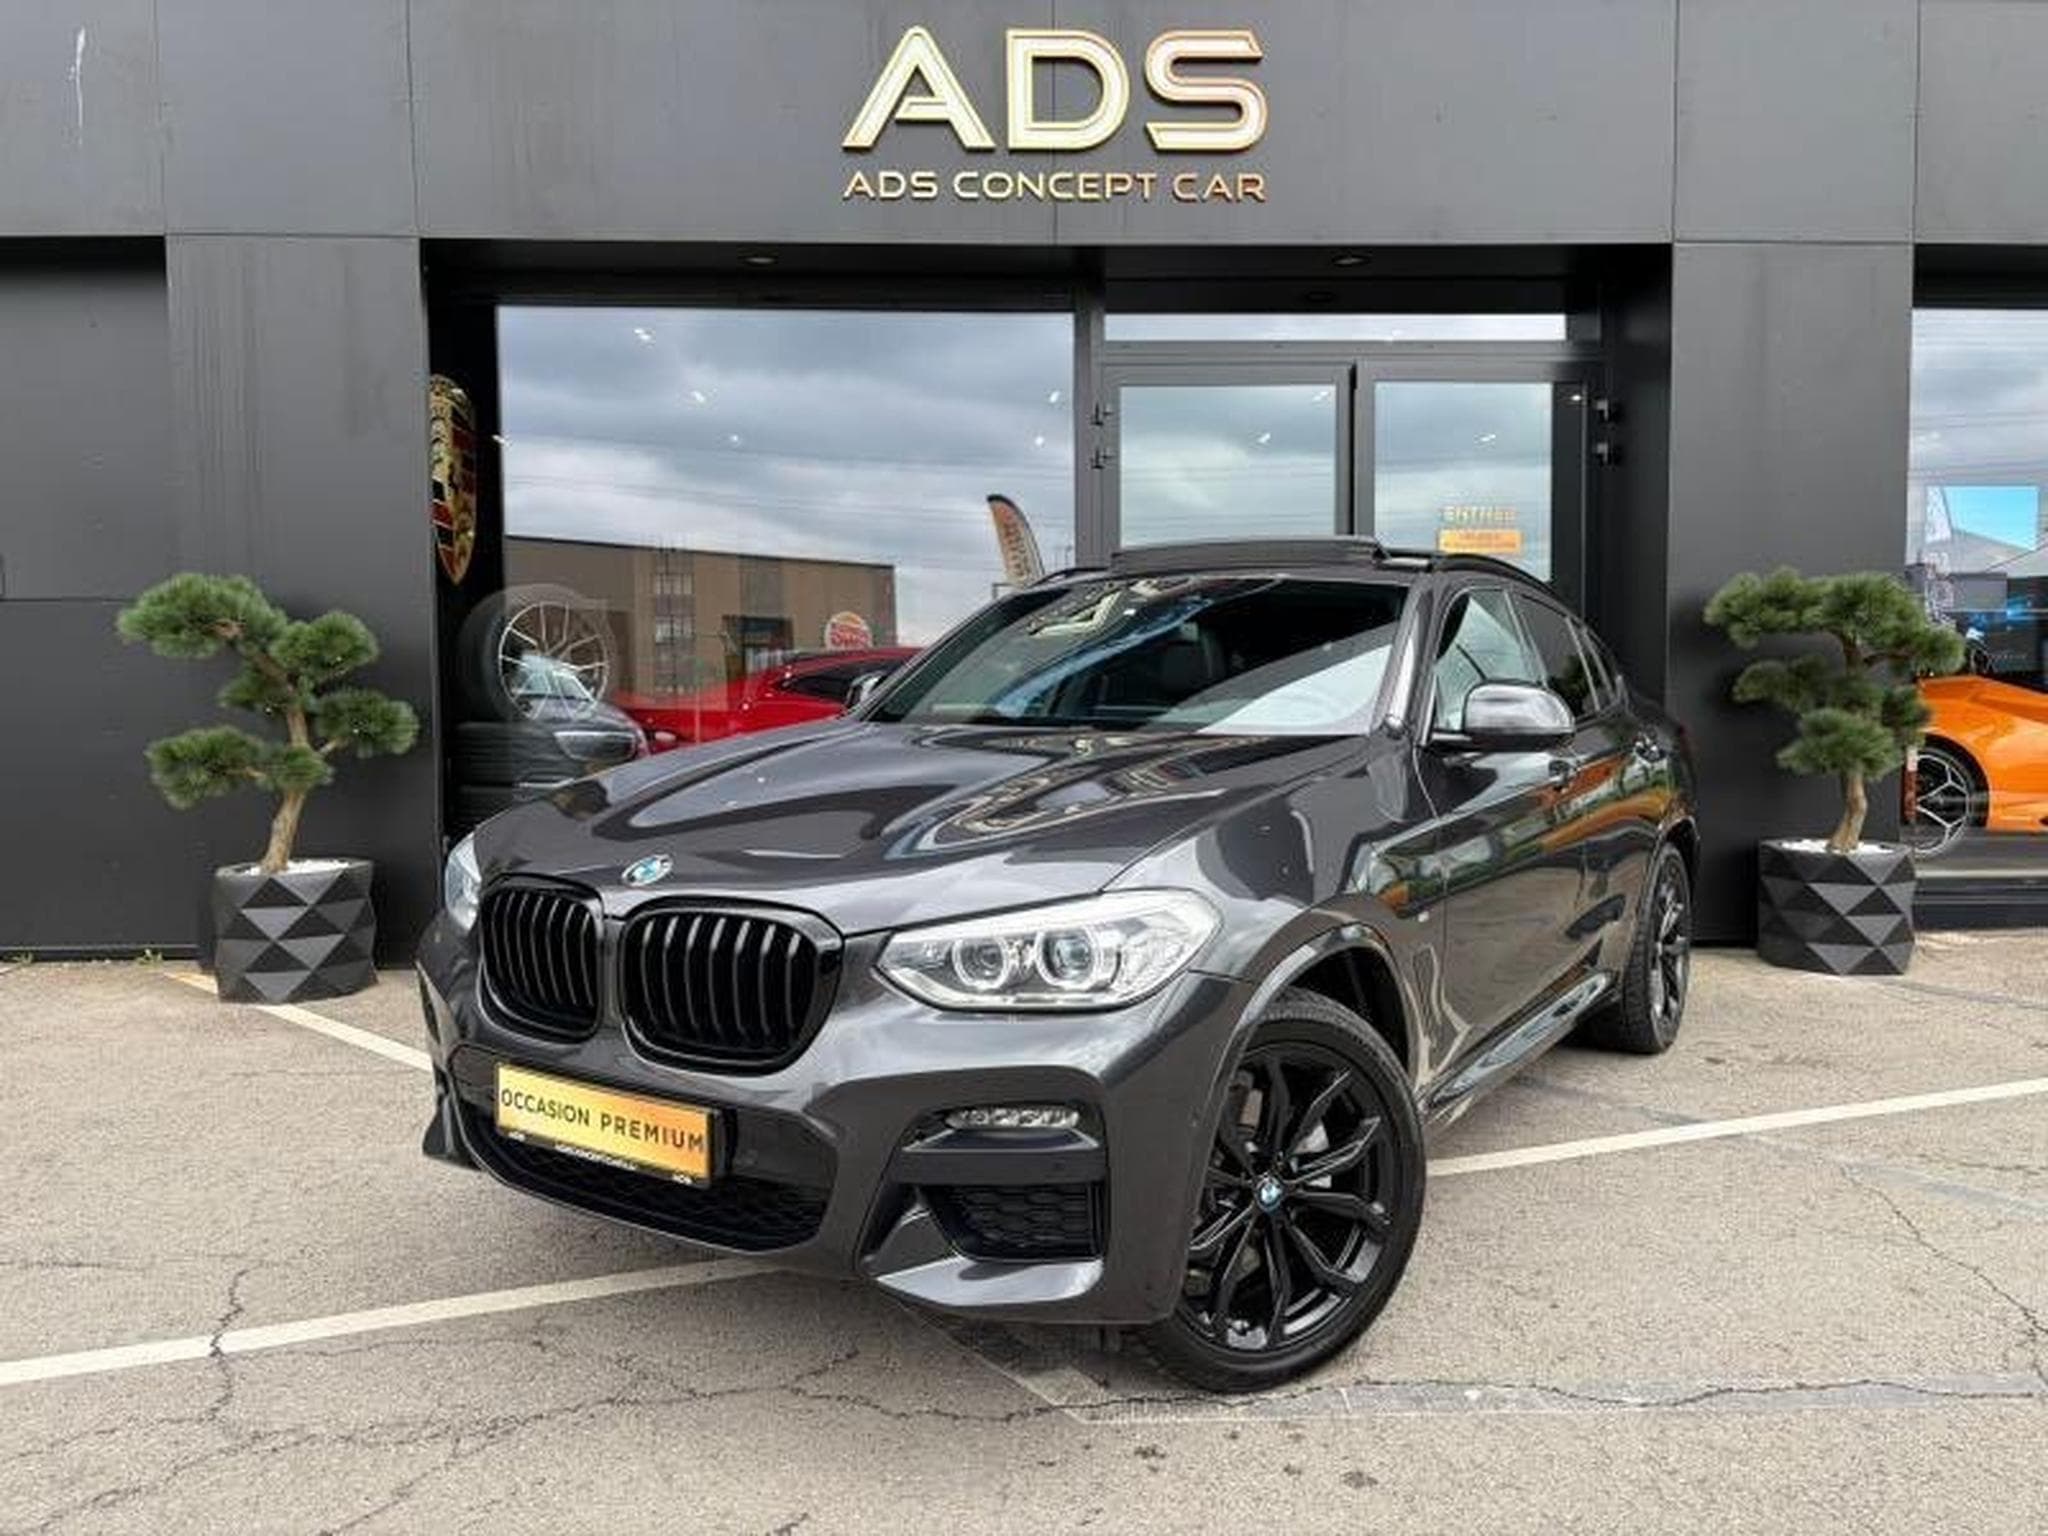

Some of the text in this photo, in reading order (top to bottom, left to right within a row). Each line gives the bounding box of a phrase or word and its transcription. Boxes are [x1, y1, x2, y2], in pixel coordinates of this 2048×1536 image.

[842, 25, 1269, 152] ADS
[843, 171, 1267, 202] ADS CONCEPT CAR
[500, 1088, 704, 1151] OCCASION PREMIUM
